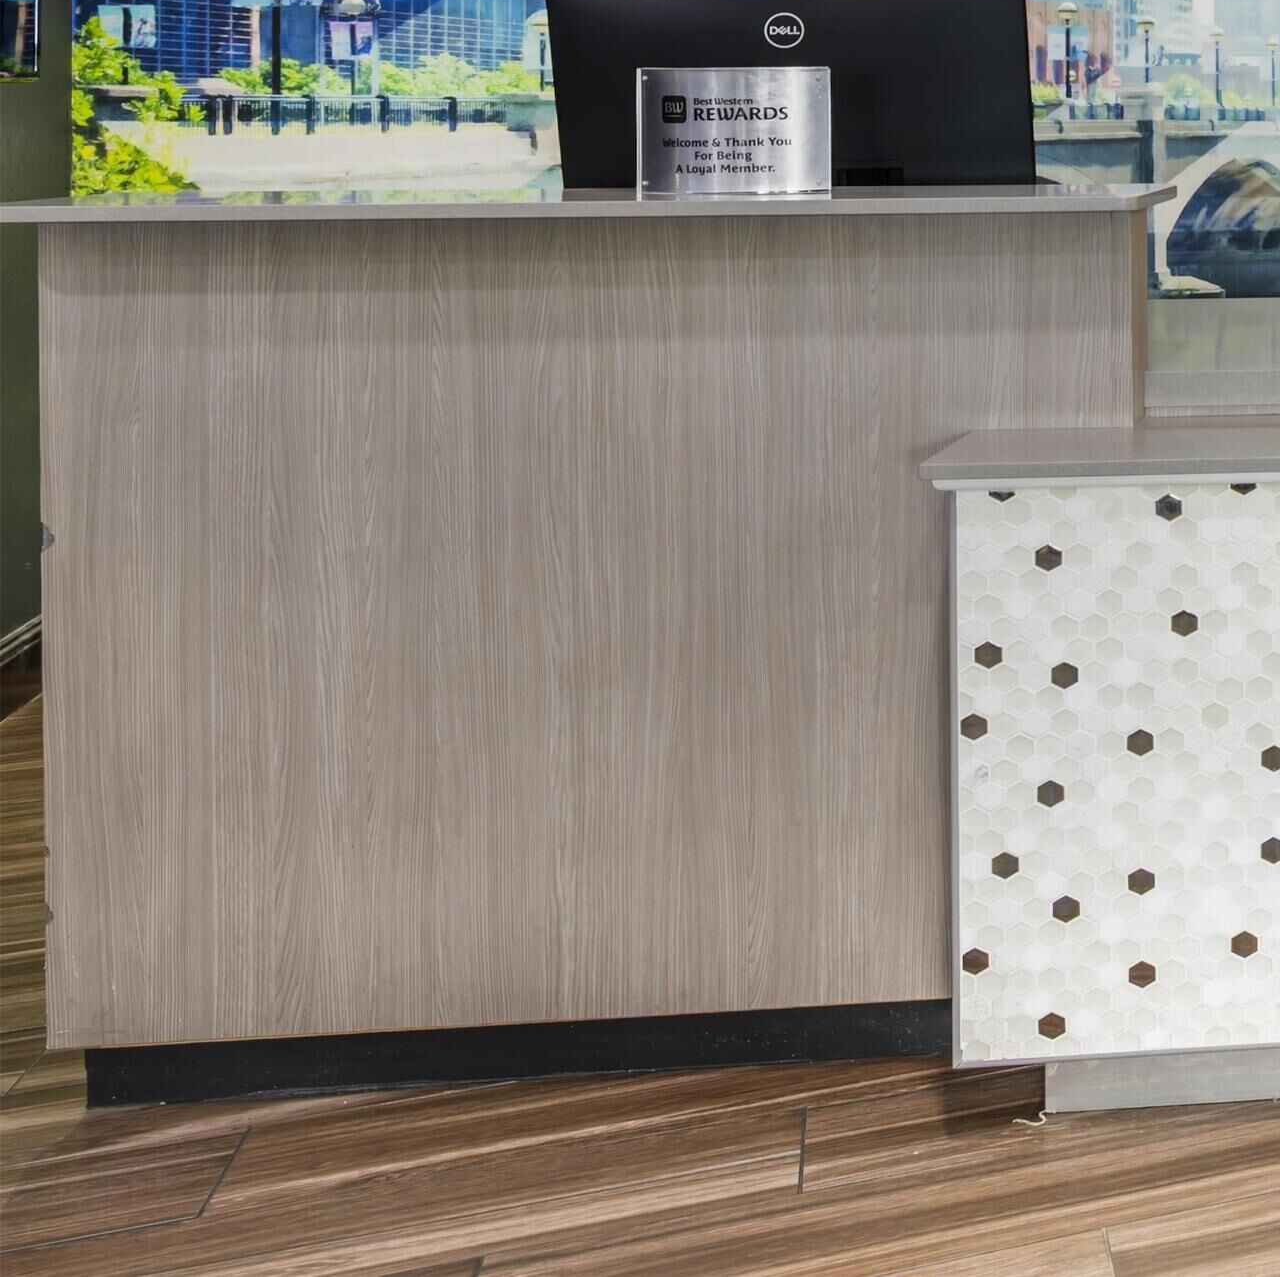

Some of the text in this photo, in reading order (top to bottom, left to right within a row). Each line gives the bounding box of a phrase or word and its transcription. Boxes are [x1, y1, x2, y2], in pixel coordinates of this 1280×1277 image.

[769, 25, 800, 36] DELL
[693, 97, 754, 106] Best Western
[694, 107, 788, 121] REWARDS
[663, 137, 792, 147] Welcome & Thank You
[694, 151, 752, 162] For Being
[676, 164, 775, 175] A Loyal Member.
